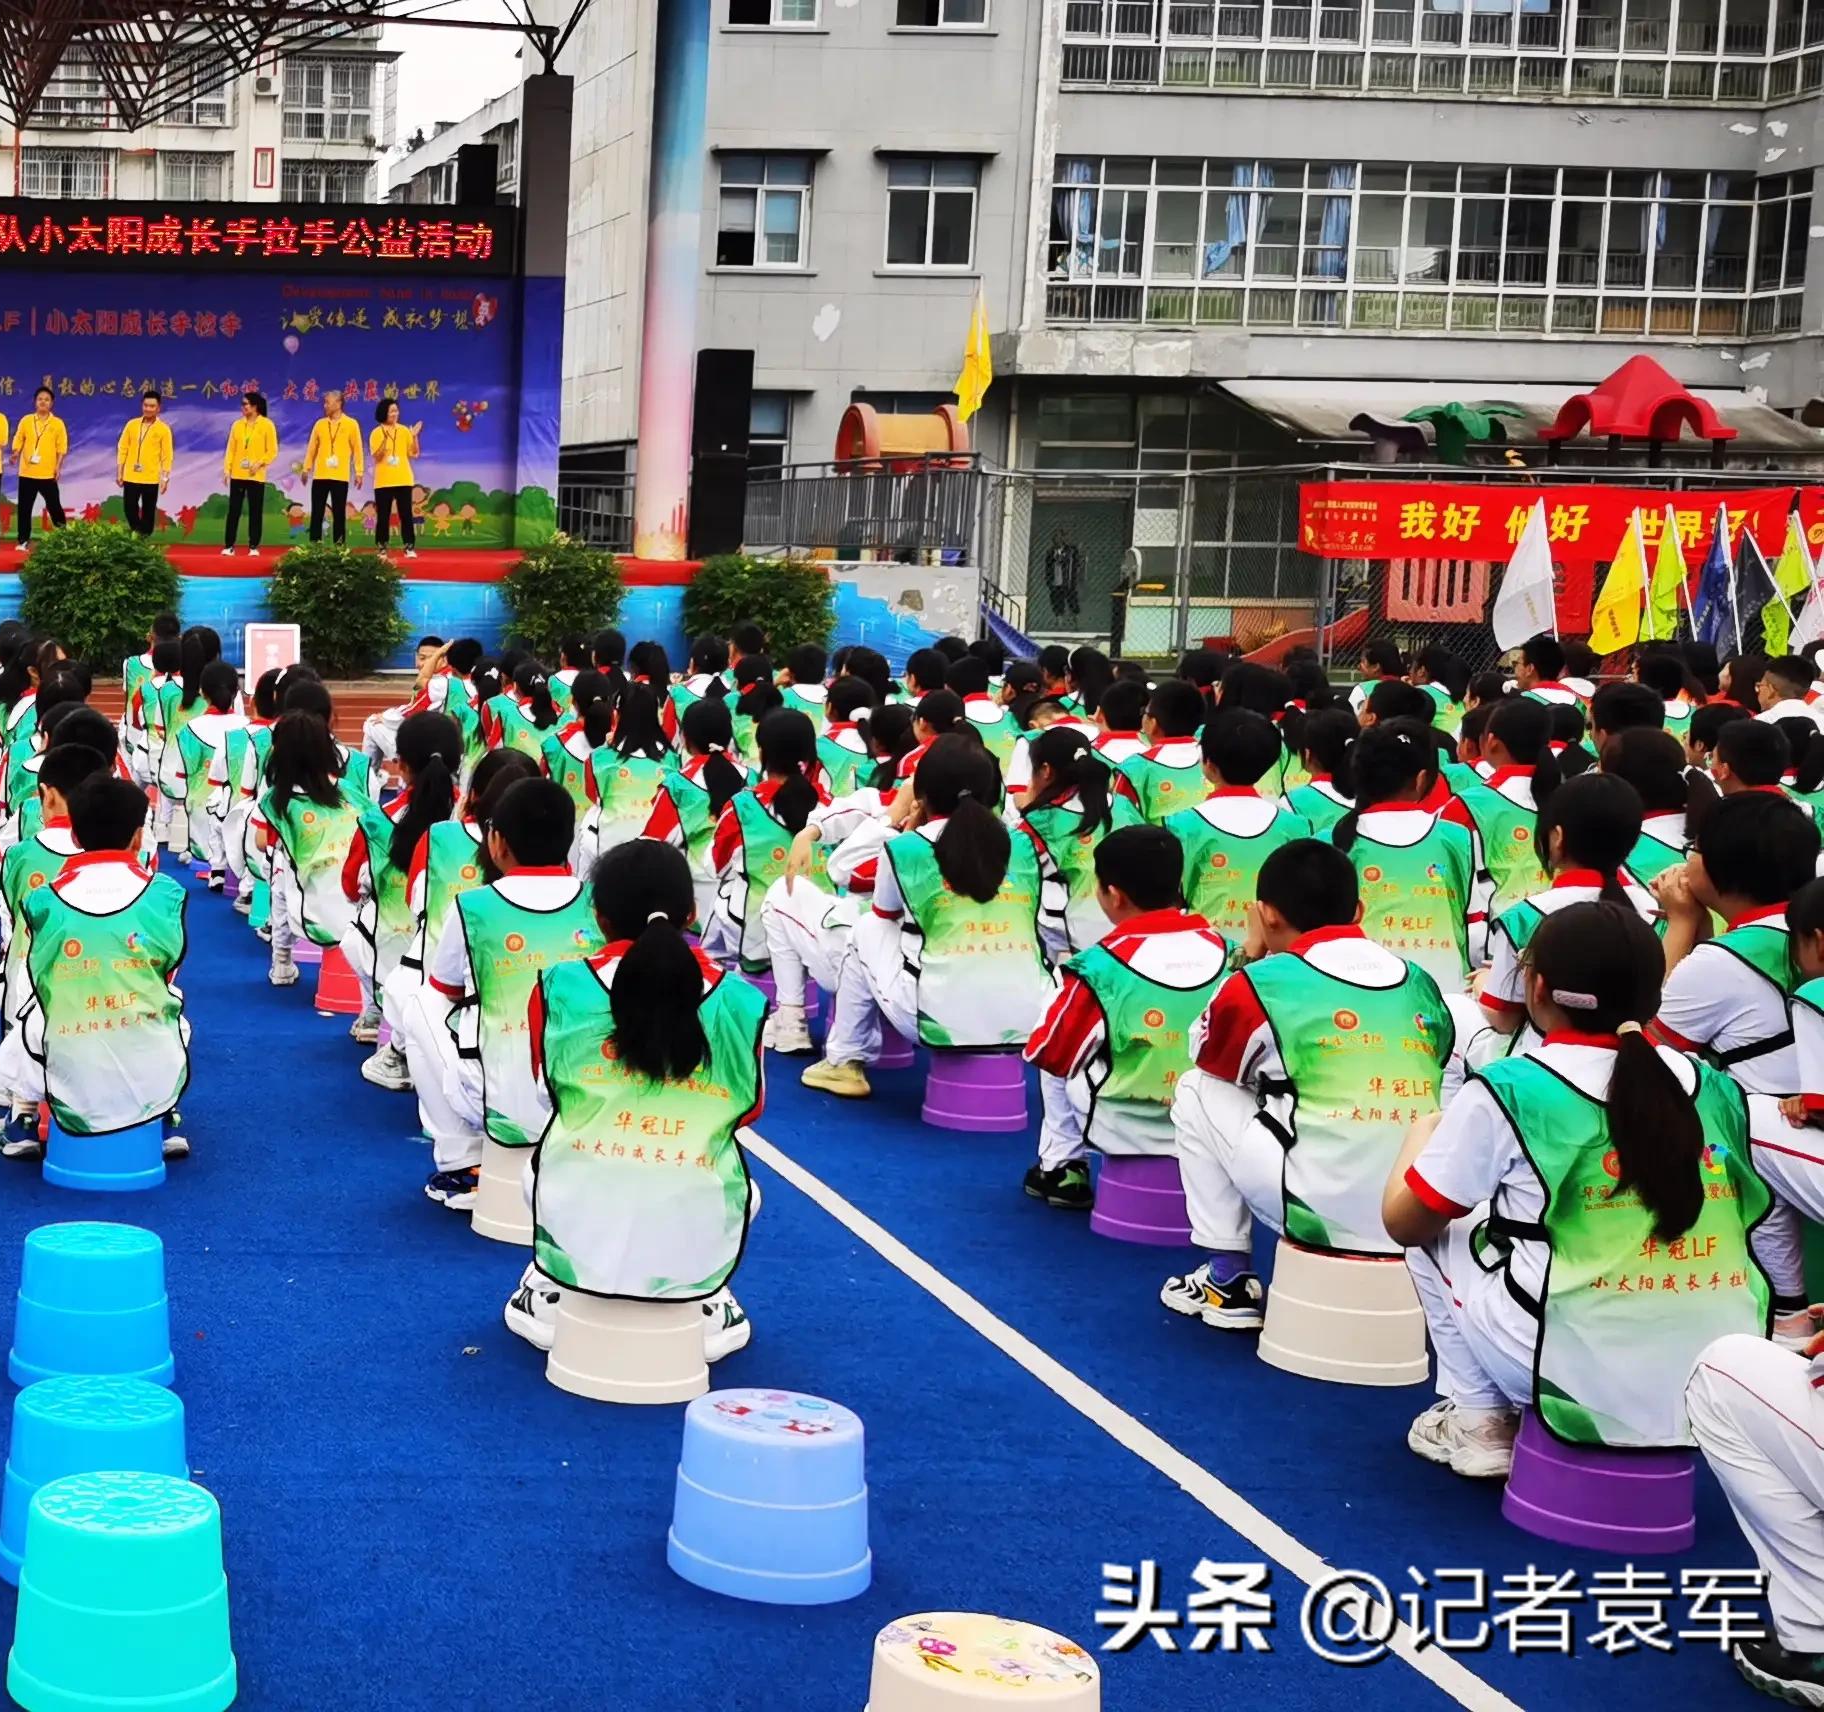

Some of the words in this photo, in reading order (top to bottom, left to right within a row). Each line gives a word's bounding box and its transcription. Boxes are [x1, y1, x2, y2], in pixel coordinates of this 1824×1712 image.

[1398, 500, 1481, 542] 我好
[1367, 1076, 1434, 1098] 华冠LF
[612, 1110, 687, 1136] 华冠LF
